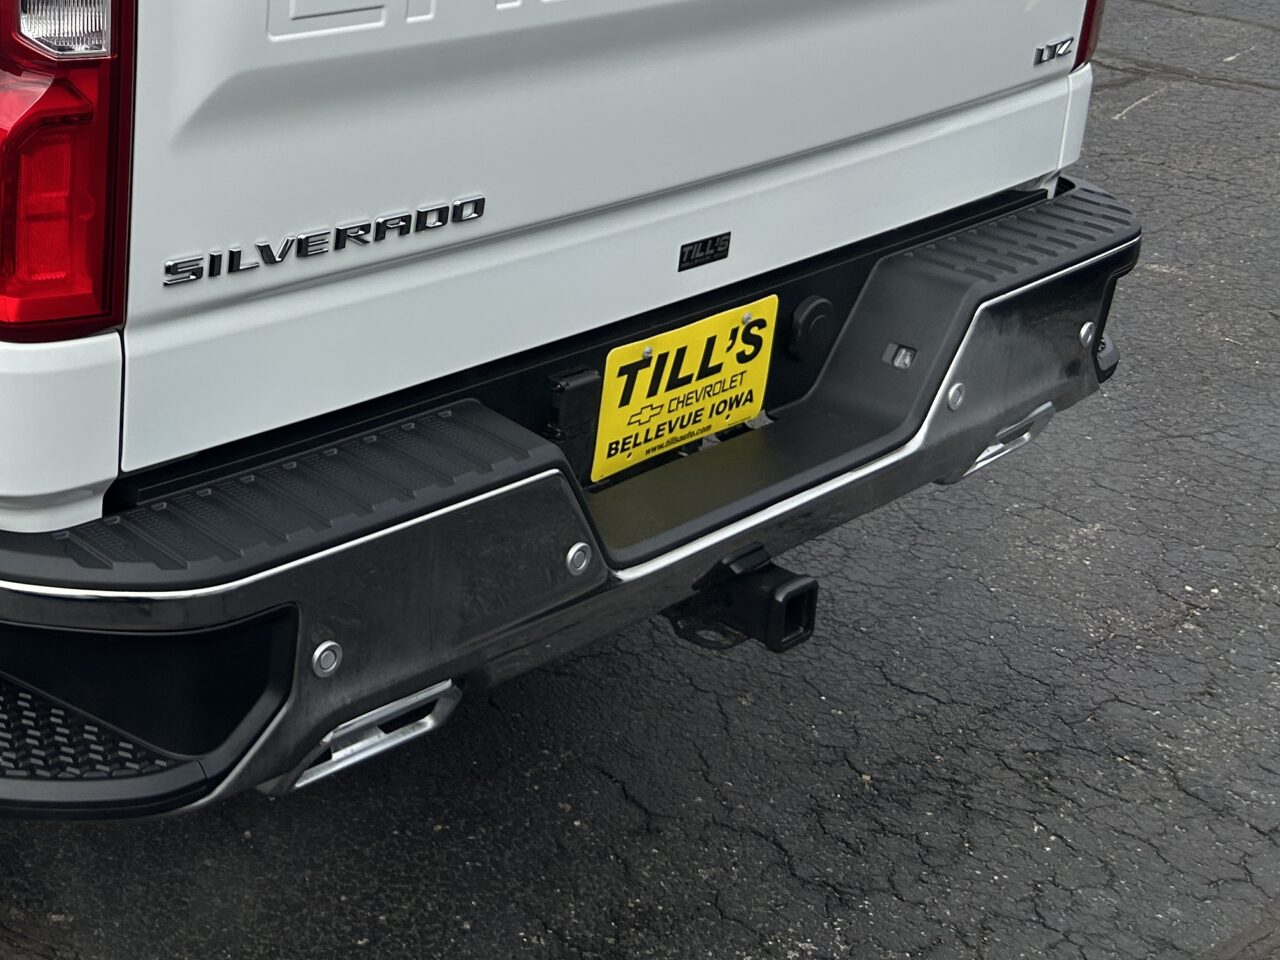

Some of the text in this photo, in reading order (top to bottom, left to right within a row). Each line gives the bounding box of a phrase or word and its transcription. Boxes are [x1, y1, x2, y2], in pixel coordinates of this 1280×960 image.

[1033, 36, 1074, 65] LTZ
[163, 195, 487, 288] SILVERADO
[681, 235, 730, 262] TILL'S
[616, 318, 768, 409] TILL'S
[667, 370, 747, 414] CHEVROLET
[606, 389, 754, 460] BELLEVUE IOWA
